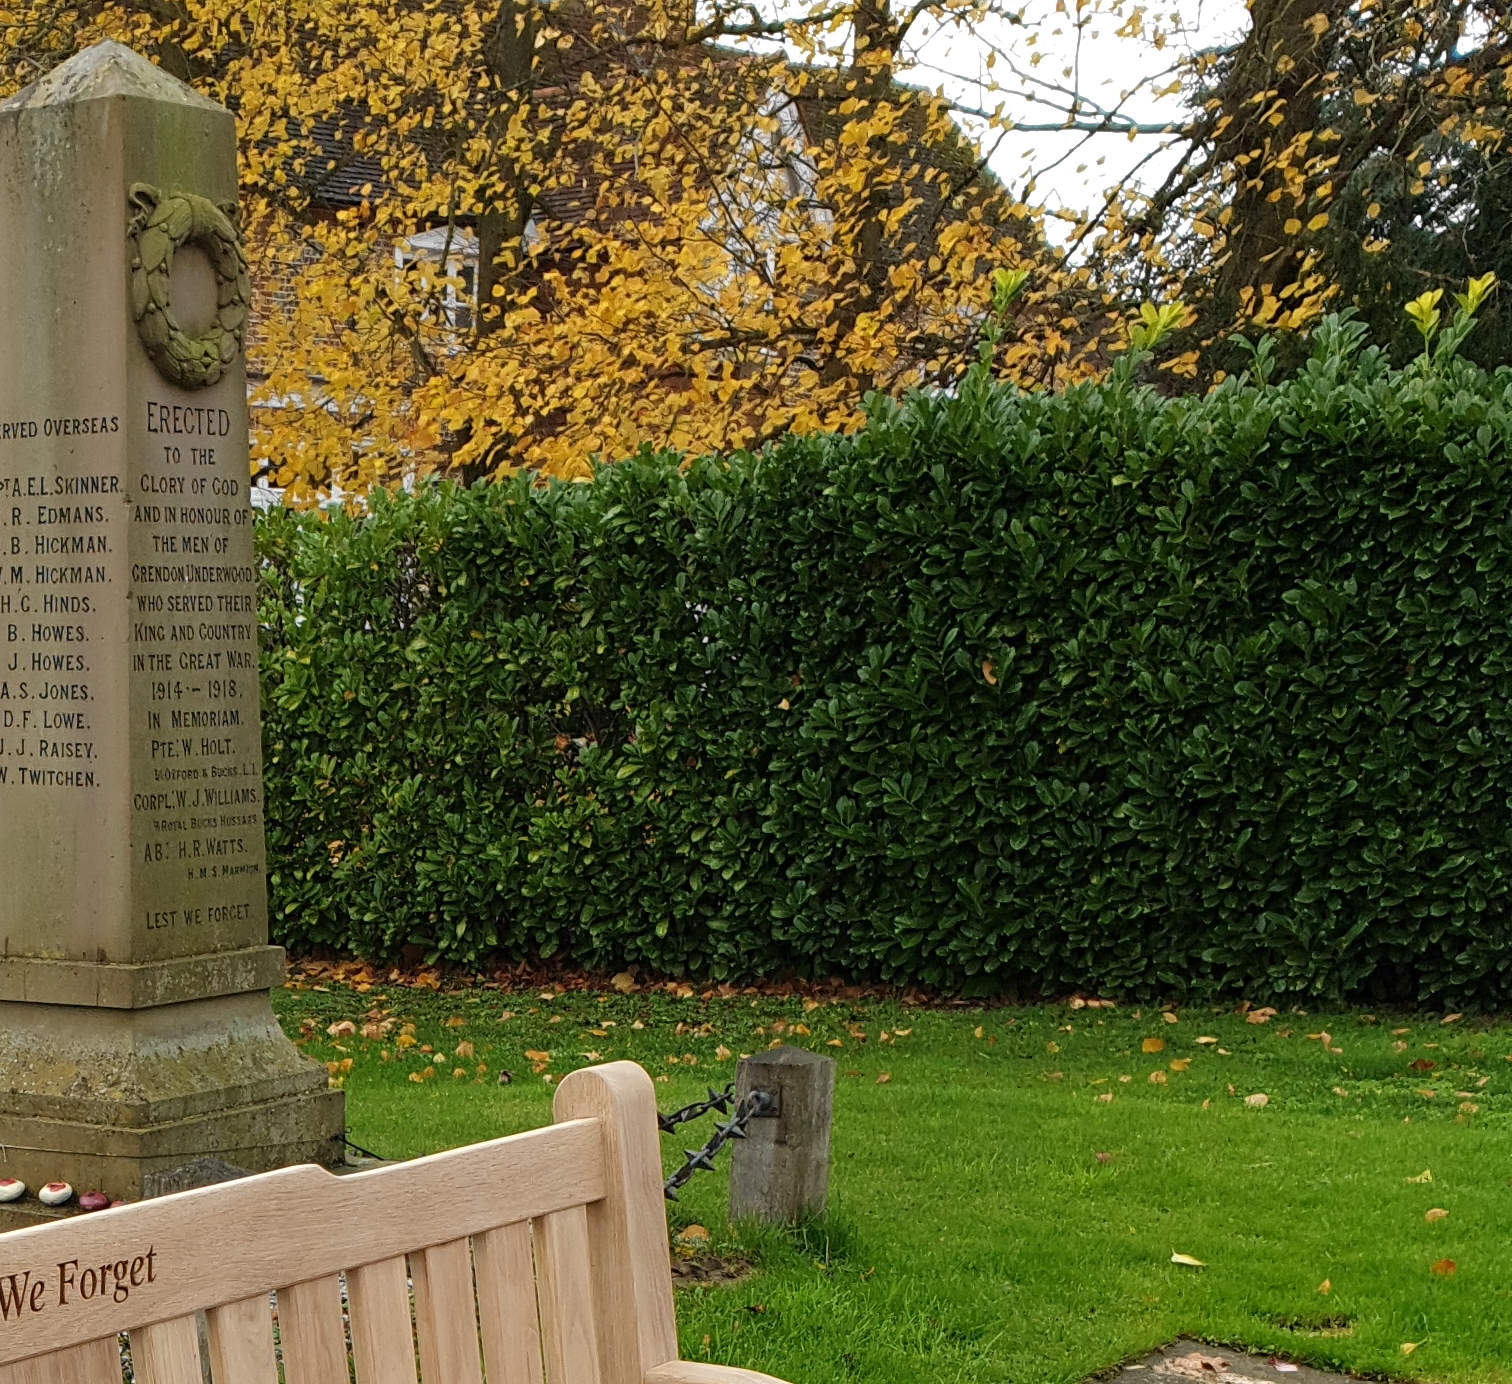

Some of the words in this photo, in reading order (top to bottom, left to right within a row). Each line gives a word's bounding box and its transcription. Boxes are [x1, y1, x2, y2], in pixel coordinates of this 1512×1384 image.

[43, 417, 119, 437] OVERSEAS
[147, 401, 230, 437] ERECTED
[163, 446, 181, 464] TO
[190, 447, 216, 466] THE
[140, 474, 185, 495] GLORY
[190, 478, 207, 496] OF
[212, 476, 239, 497] GOD
[37, 506, 110, 525] EDMANS.
[134, 505, 160, 523] AND
[164, 506, 176, 523] IN
[181, 506, 230, 525] HONOUR
[233, 509, 249, 526] OF
[34, 535, 113, 555] HICKMAN.
[152, 535, 178, 553] THE
[182, 536, 209, 554] MEN
[214, 537, 229, 554] OF
[35, 565, 112, 585] HICKMAN.
[131, 563, 185, 583] GRENDON
[186, 564, 252, 583] UNDERWOOD
[43, 594, 96, 614] HINDS.
[137, 594, 164, 613] WHO
[167, 595, 213, 612] SERVED
[217, 594, 252, 612] THEIR
[7, 623, 25, 643] B.
[31, 623, 90, 643] HOWES.
[134, 622, 165, 642] KING
[171, 624, 195, 641] AND
[198, 622, 252, 641] COUNTRY
[7, 652, 26, 672] J.
[31, 652, 90, 672] HOWES.
[133, 653, 145, 672] IN
[148, 653, 172, 671] THE
[179, 651, 221, 671] GREAT
[152, 681, 183, 700] 1914
[43, 710, 90, 729] LOWE.
[148, 711, 160, 729] IN
[171, 710, 245, 729] MEMORIAM.
[39, 739, 98, 760] RAISEY.
[201, 738, 236, 757] HOLT.
[18, 767, 100, 788] TWITCHEN.
[205, 837, 248, 856] WATTS.
[147, 911, 177, 930] LEST
[183, 908, 201, 927] WE
[208, 903, 250, 922] FORGET
[56, 1245, 157, 1304] Forget
